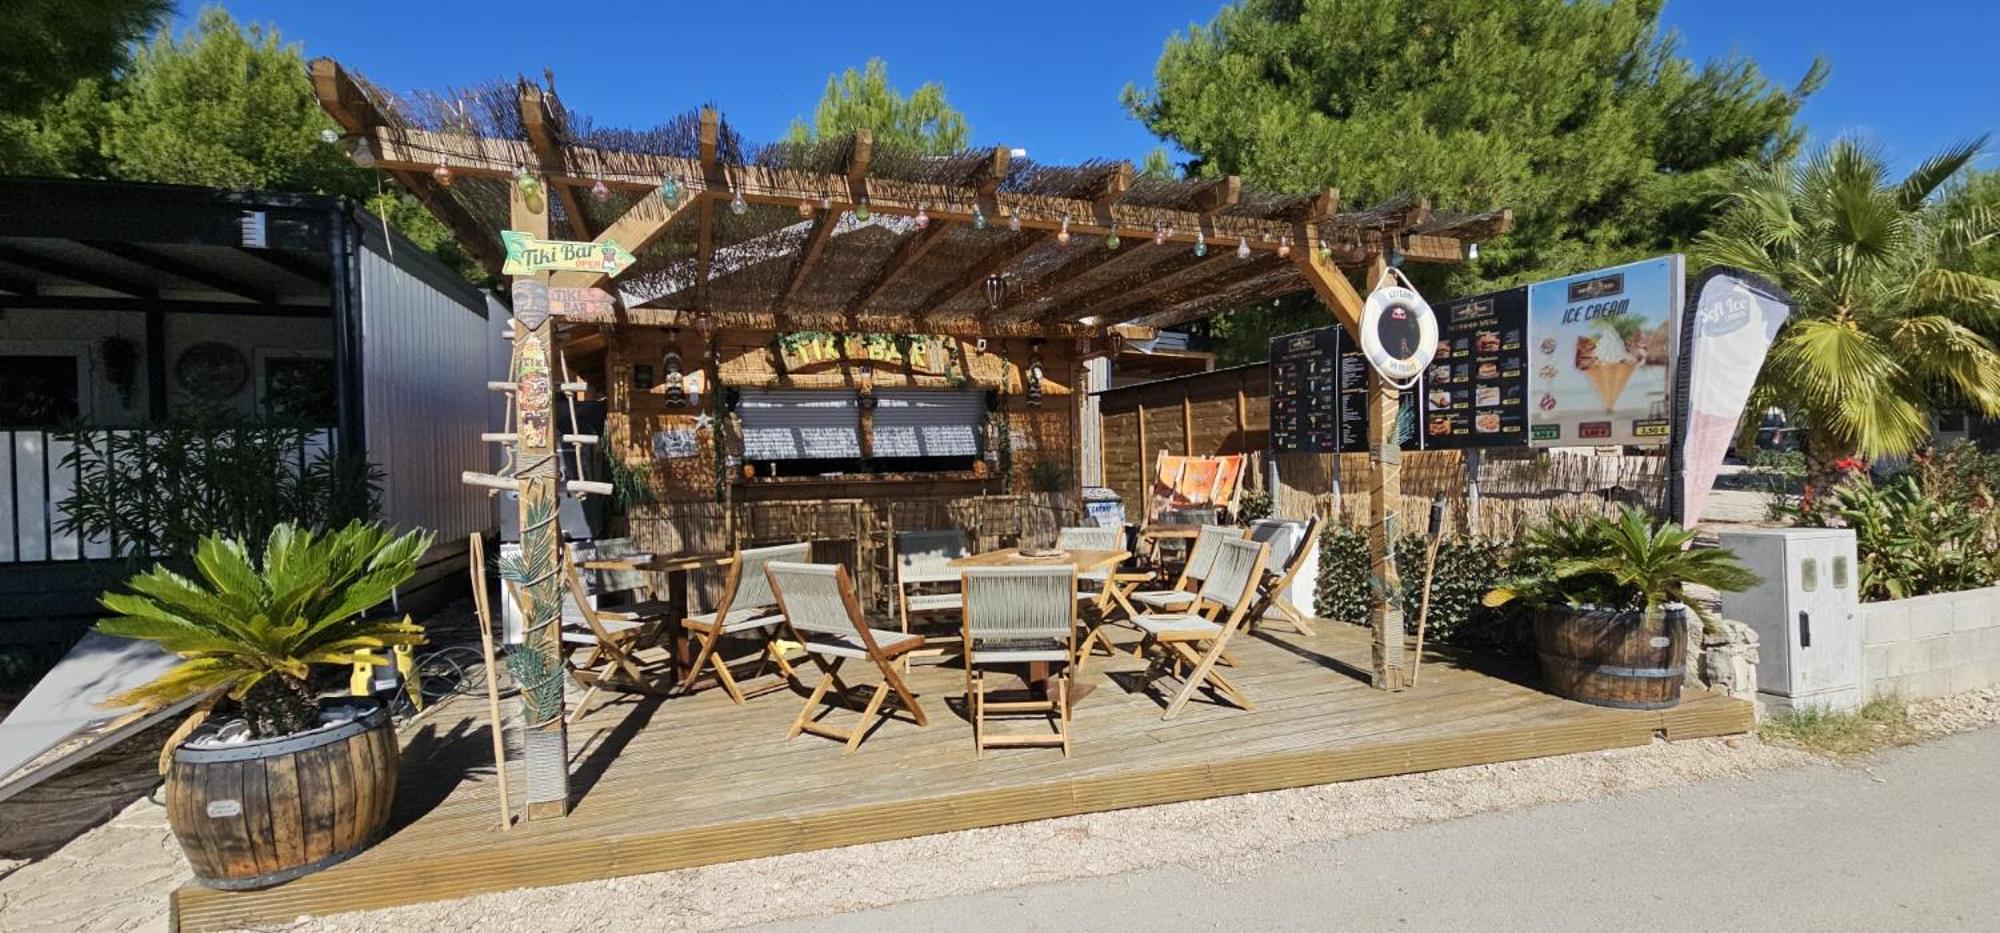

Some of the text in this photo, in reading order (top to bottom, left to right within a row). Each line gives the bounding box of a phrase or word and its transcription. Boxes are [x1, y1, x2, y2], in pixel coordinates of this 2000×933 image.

[521, 244, 597, 267] Tiki Bar
[575, 259, 600, 268] OPEN
[553, 288, 583, 301] TIKI
[563, 301, 588, 313] BAR
[1562, 298, 1630, 324] ICE CREAM
[1701, 301, 1726, 323] Soft
[1727, 297, 1746, 313] Ice
